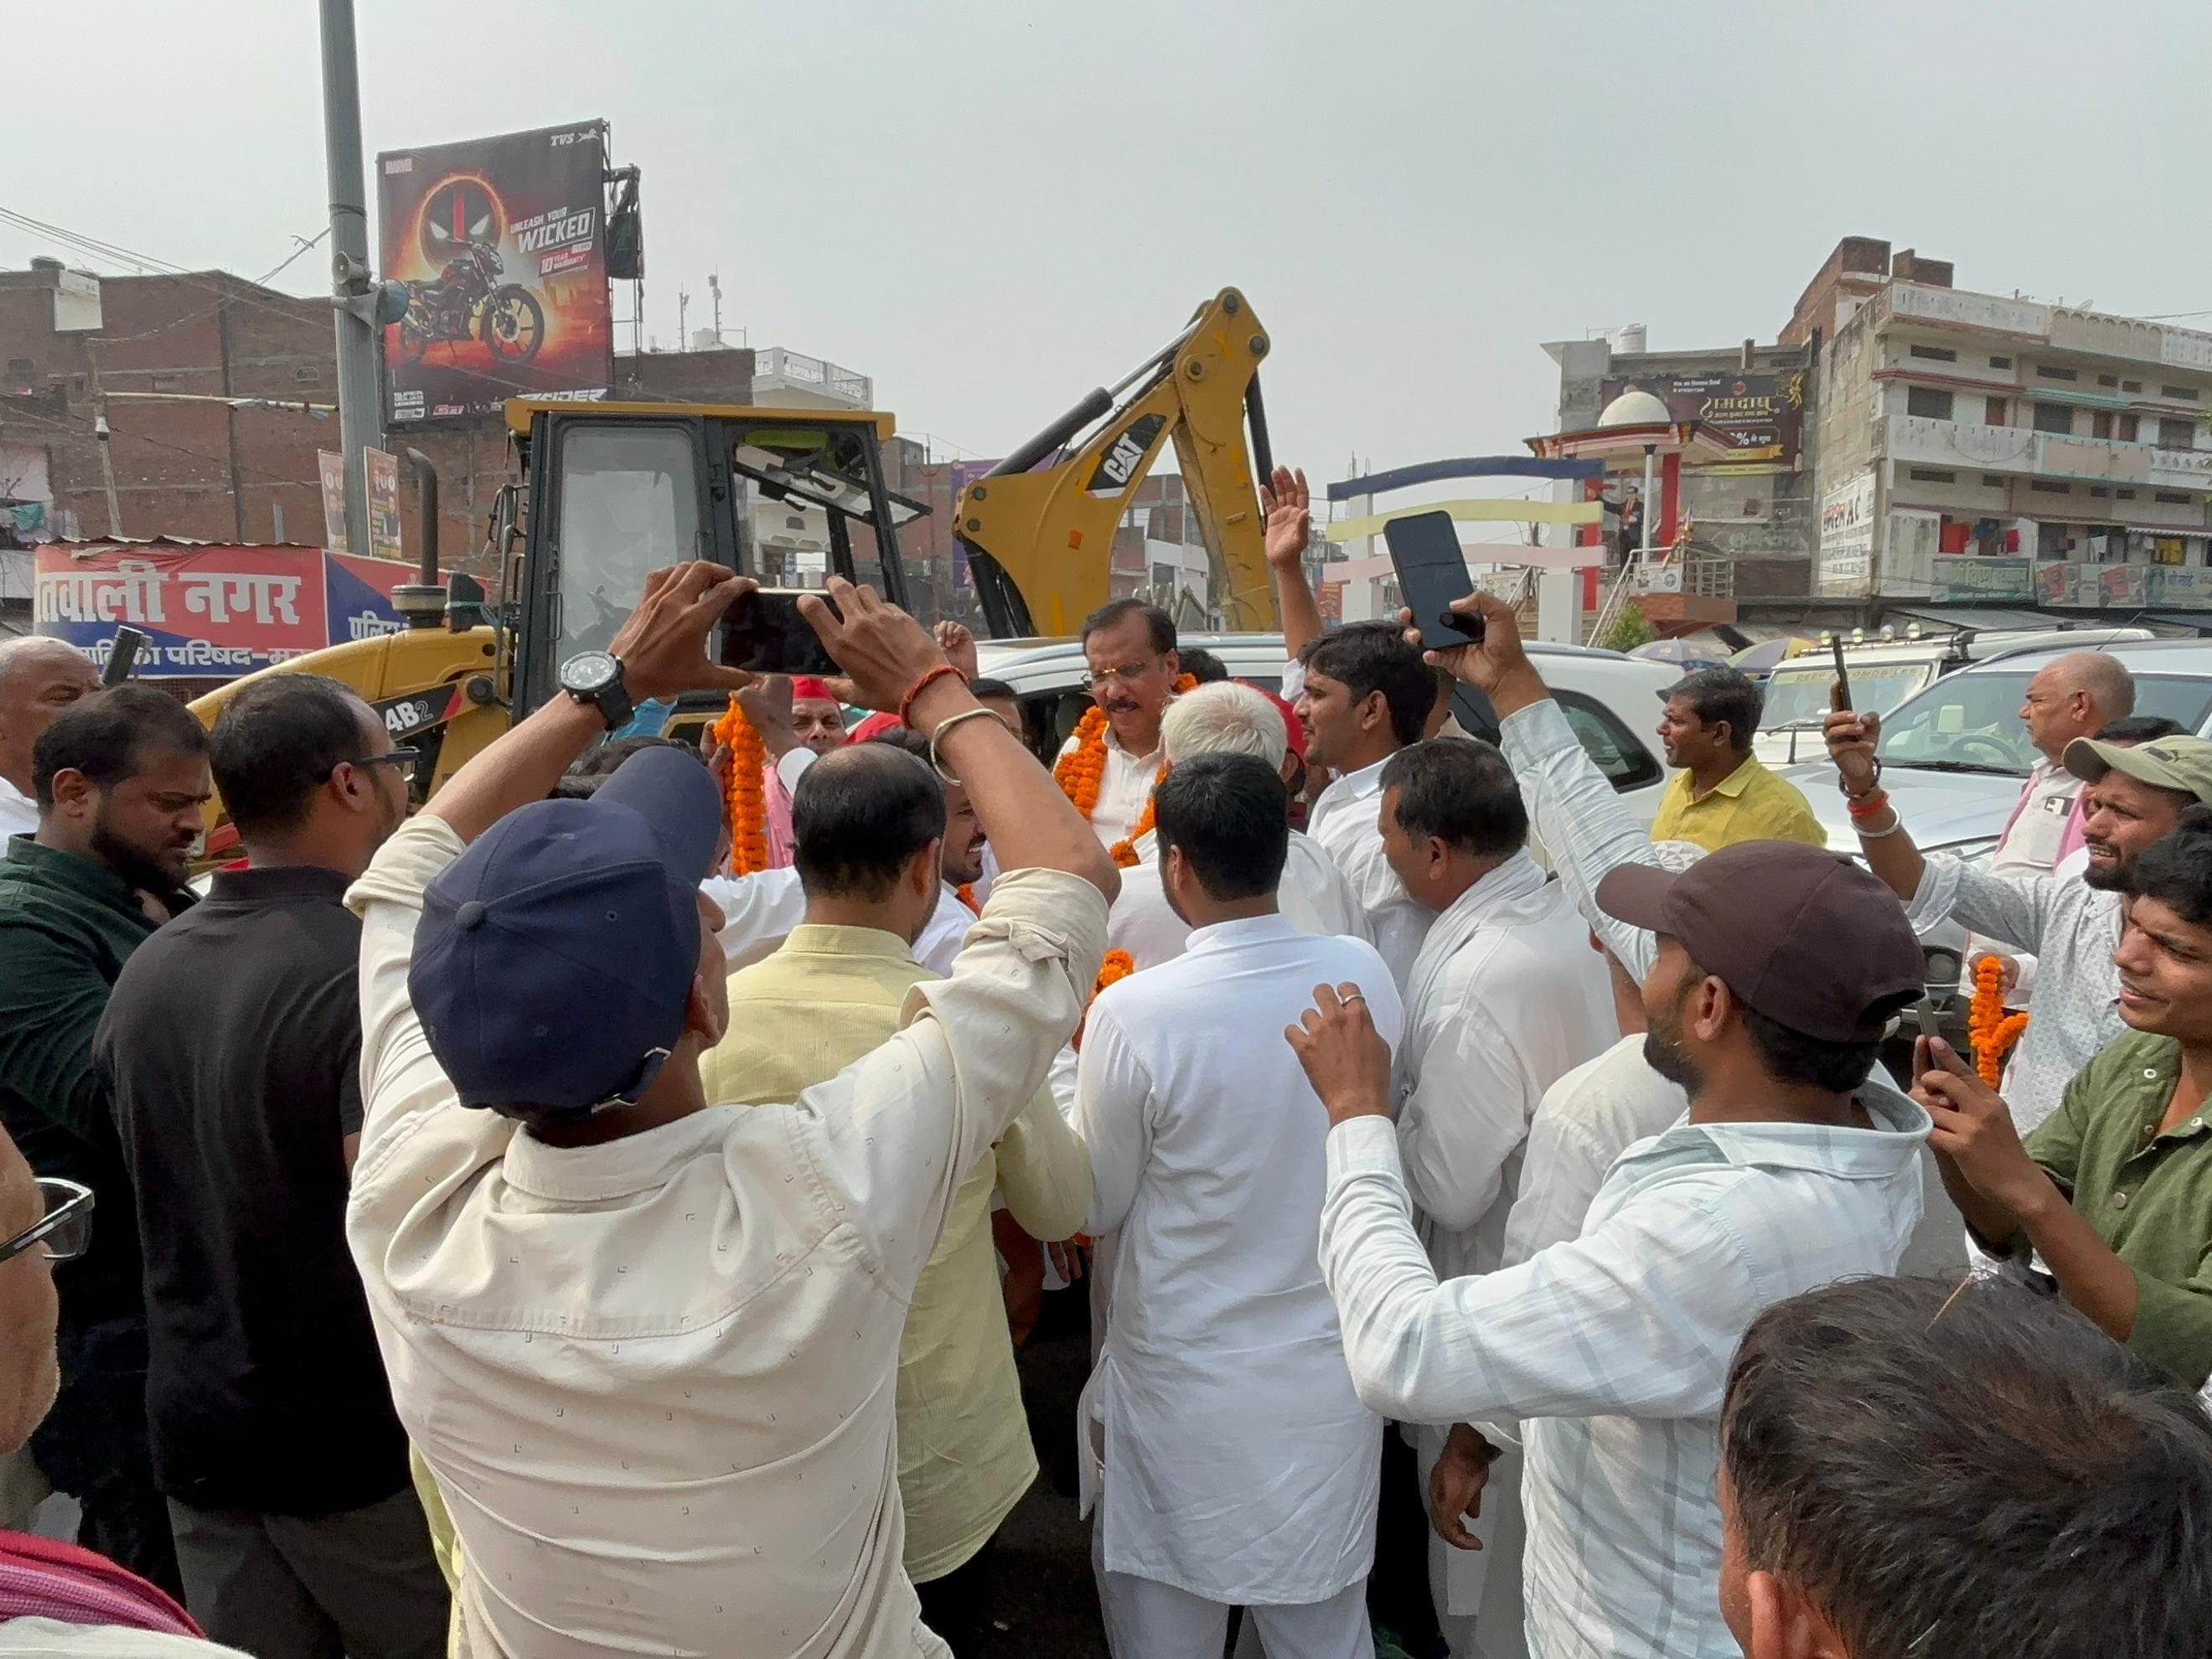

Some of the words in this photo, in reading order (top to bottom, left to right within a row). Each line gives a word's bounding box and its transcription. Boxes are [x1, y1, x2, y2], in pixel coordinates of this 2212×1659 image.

[550, 132, 575, 147] TVS
[510, 214, 545, 234] UNLEASH
[547, 206, 567, 222] YOUR
[518, 212, 590, 254] WICKED
[1103, 432, 1144, 483] CAT
[34, 560, 169, 623] तवाली
[178, 572, 302, 625] नगर
[1830, 667, 1918, 680] AOMOBILES
